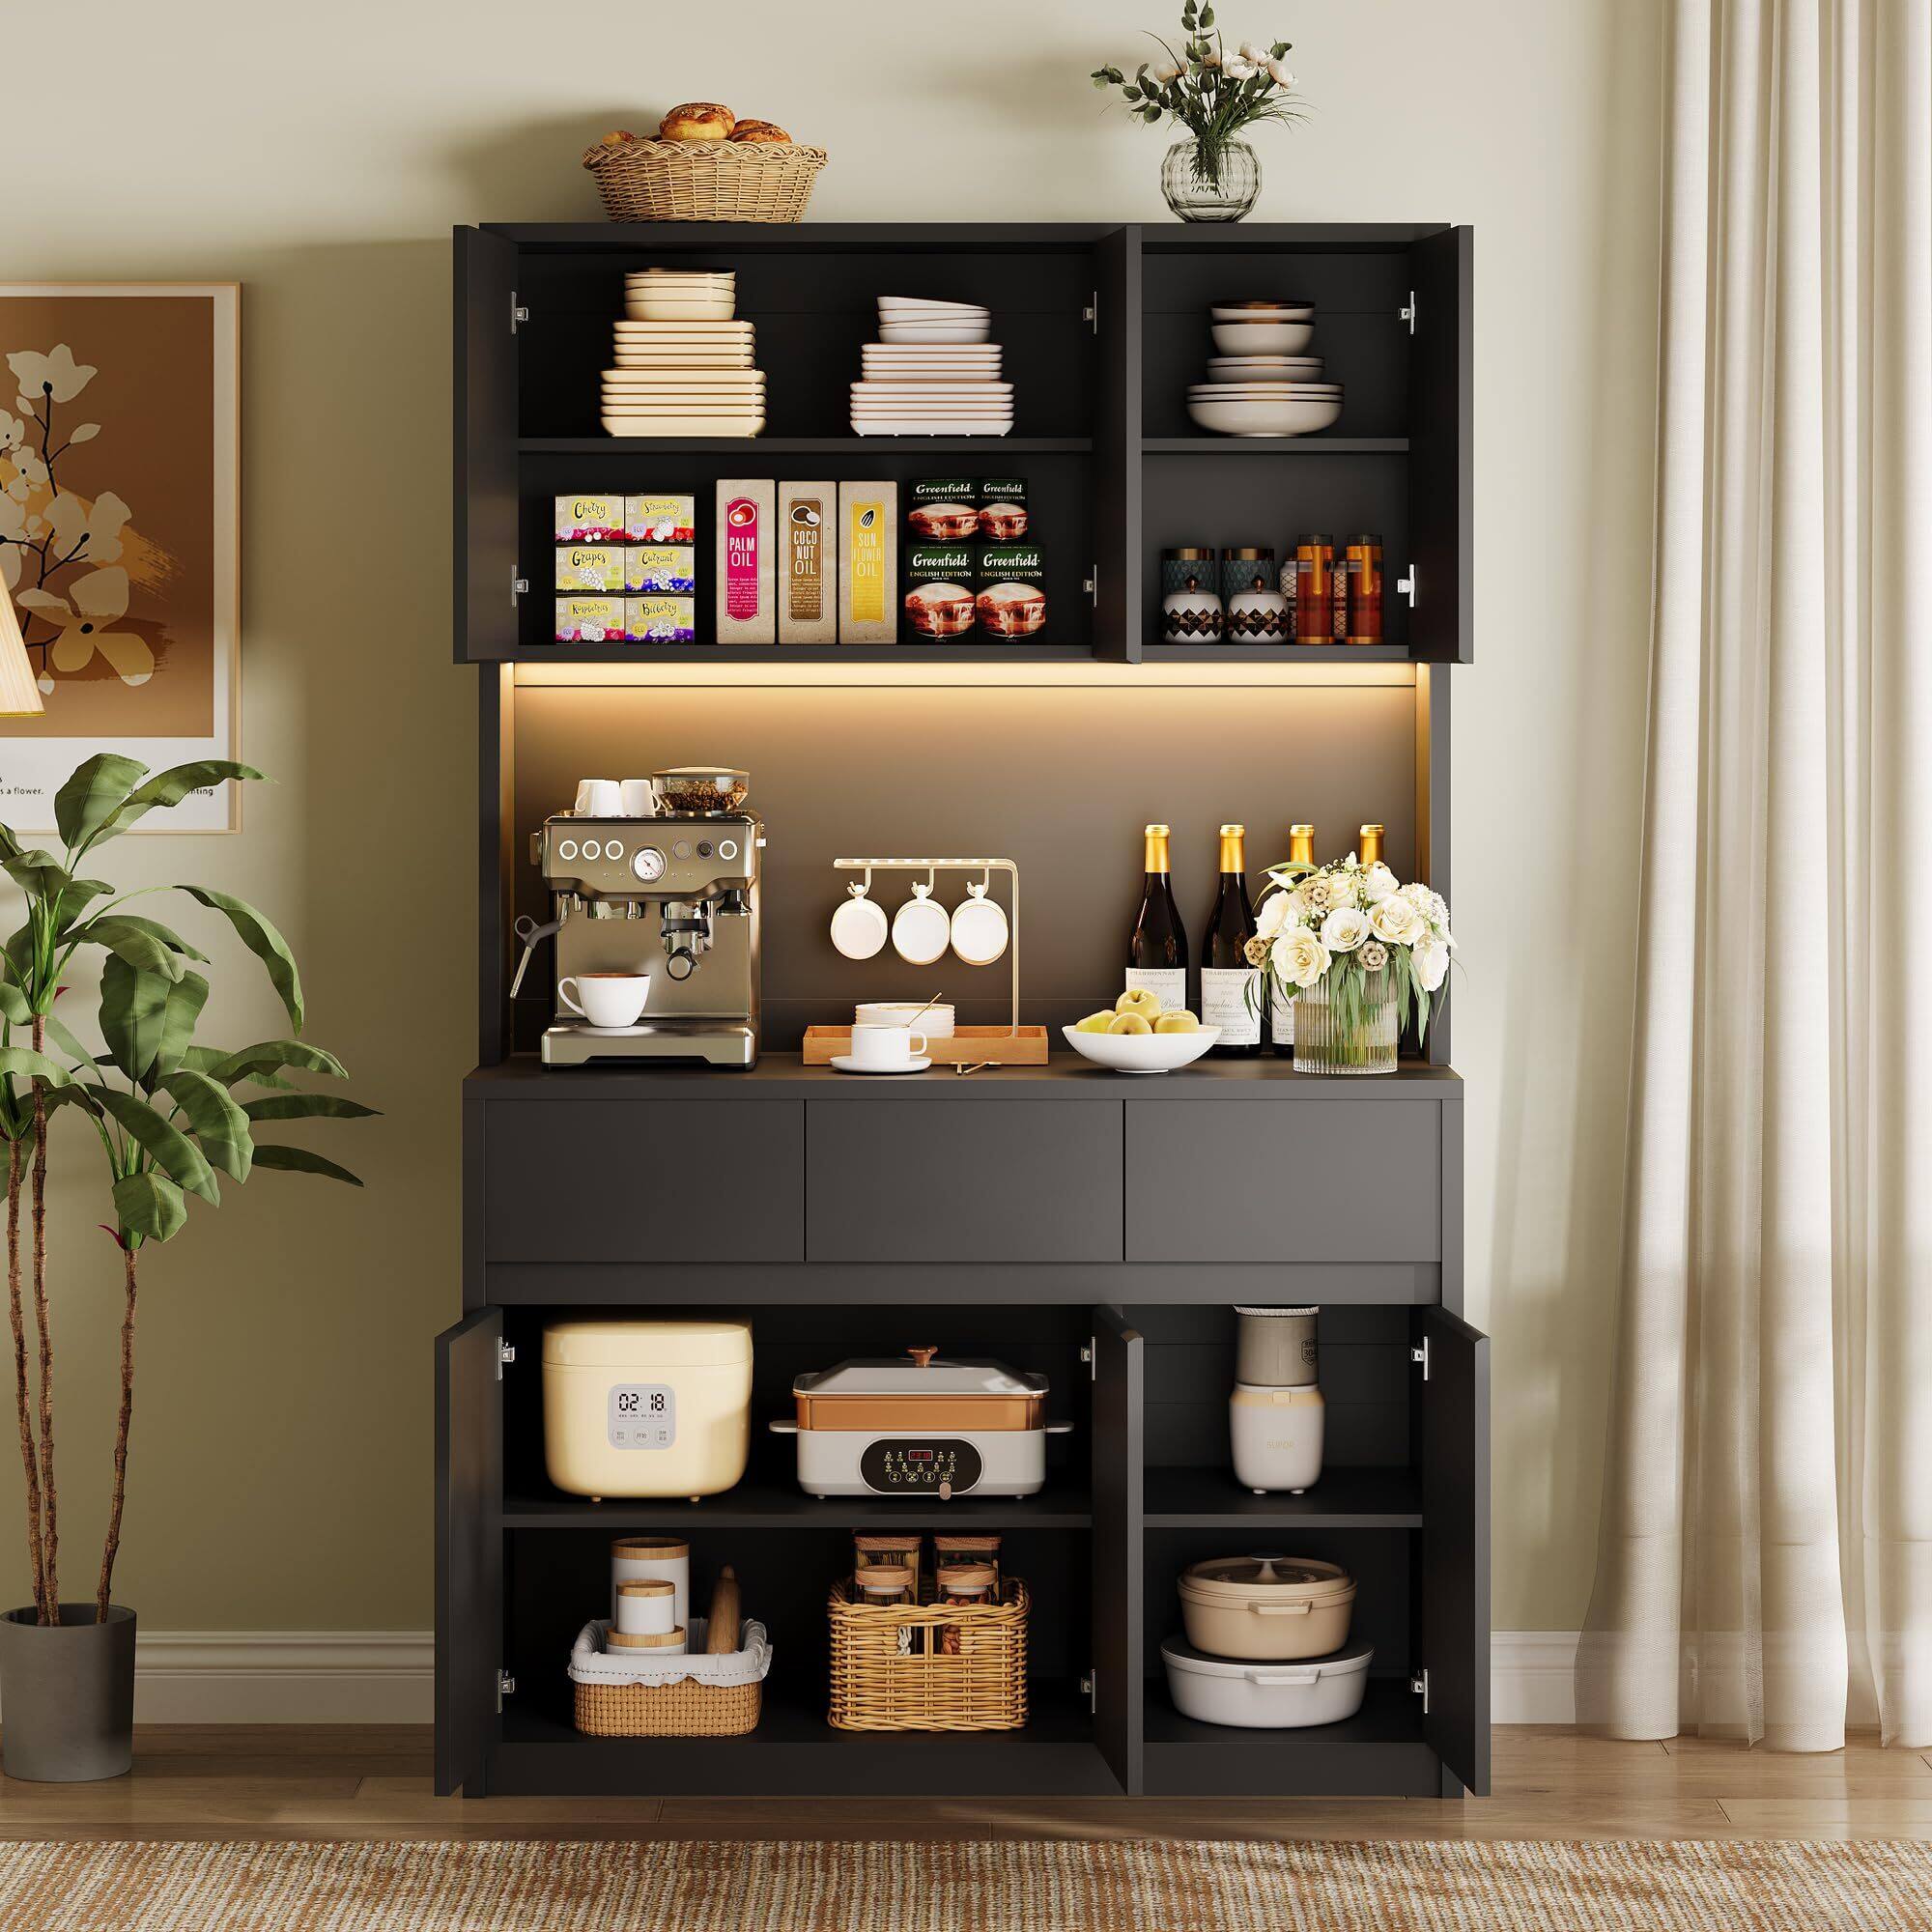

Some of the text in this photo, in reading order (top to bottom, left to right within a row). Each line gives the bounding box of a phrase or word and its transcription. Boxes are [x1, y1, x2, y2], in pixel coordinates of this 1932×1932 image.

[916, 483, 972, 494] Greenfield
[983, 483, 1022, 493] Greenfield
[575, 501, 606, 519] Cherry
[644, 502, 679, 514] Strawberry
[729, 537, 754, 551] PALM
[794, 530, 817, 545] COCO
[858, 532, 876, 547] SUN
[572, 551, 606, 566] Grapes
[641, 552, 673, 565] Currant
[797, 545, 814, 559] NUT
[731, 552, 753, 567] OIL
[913, 553, 967, 567] Greenfield
[983, 553, 1038, 567] Greenfield
[795, 560, 817, 575] OIL
[857, 562, 879, 577] OIL
